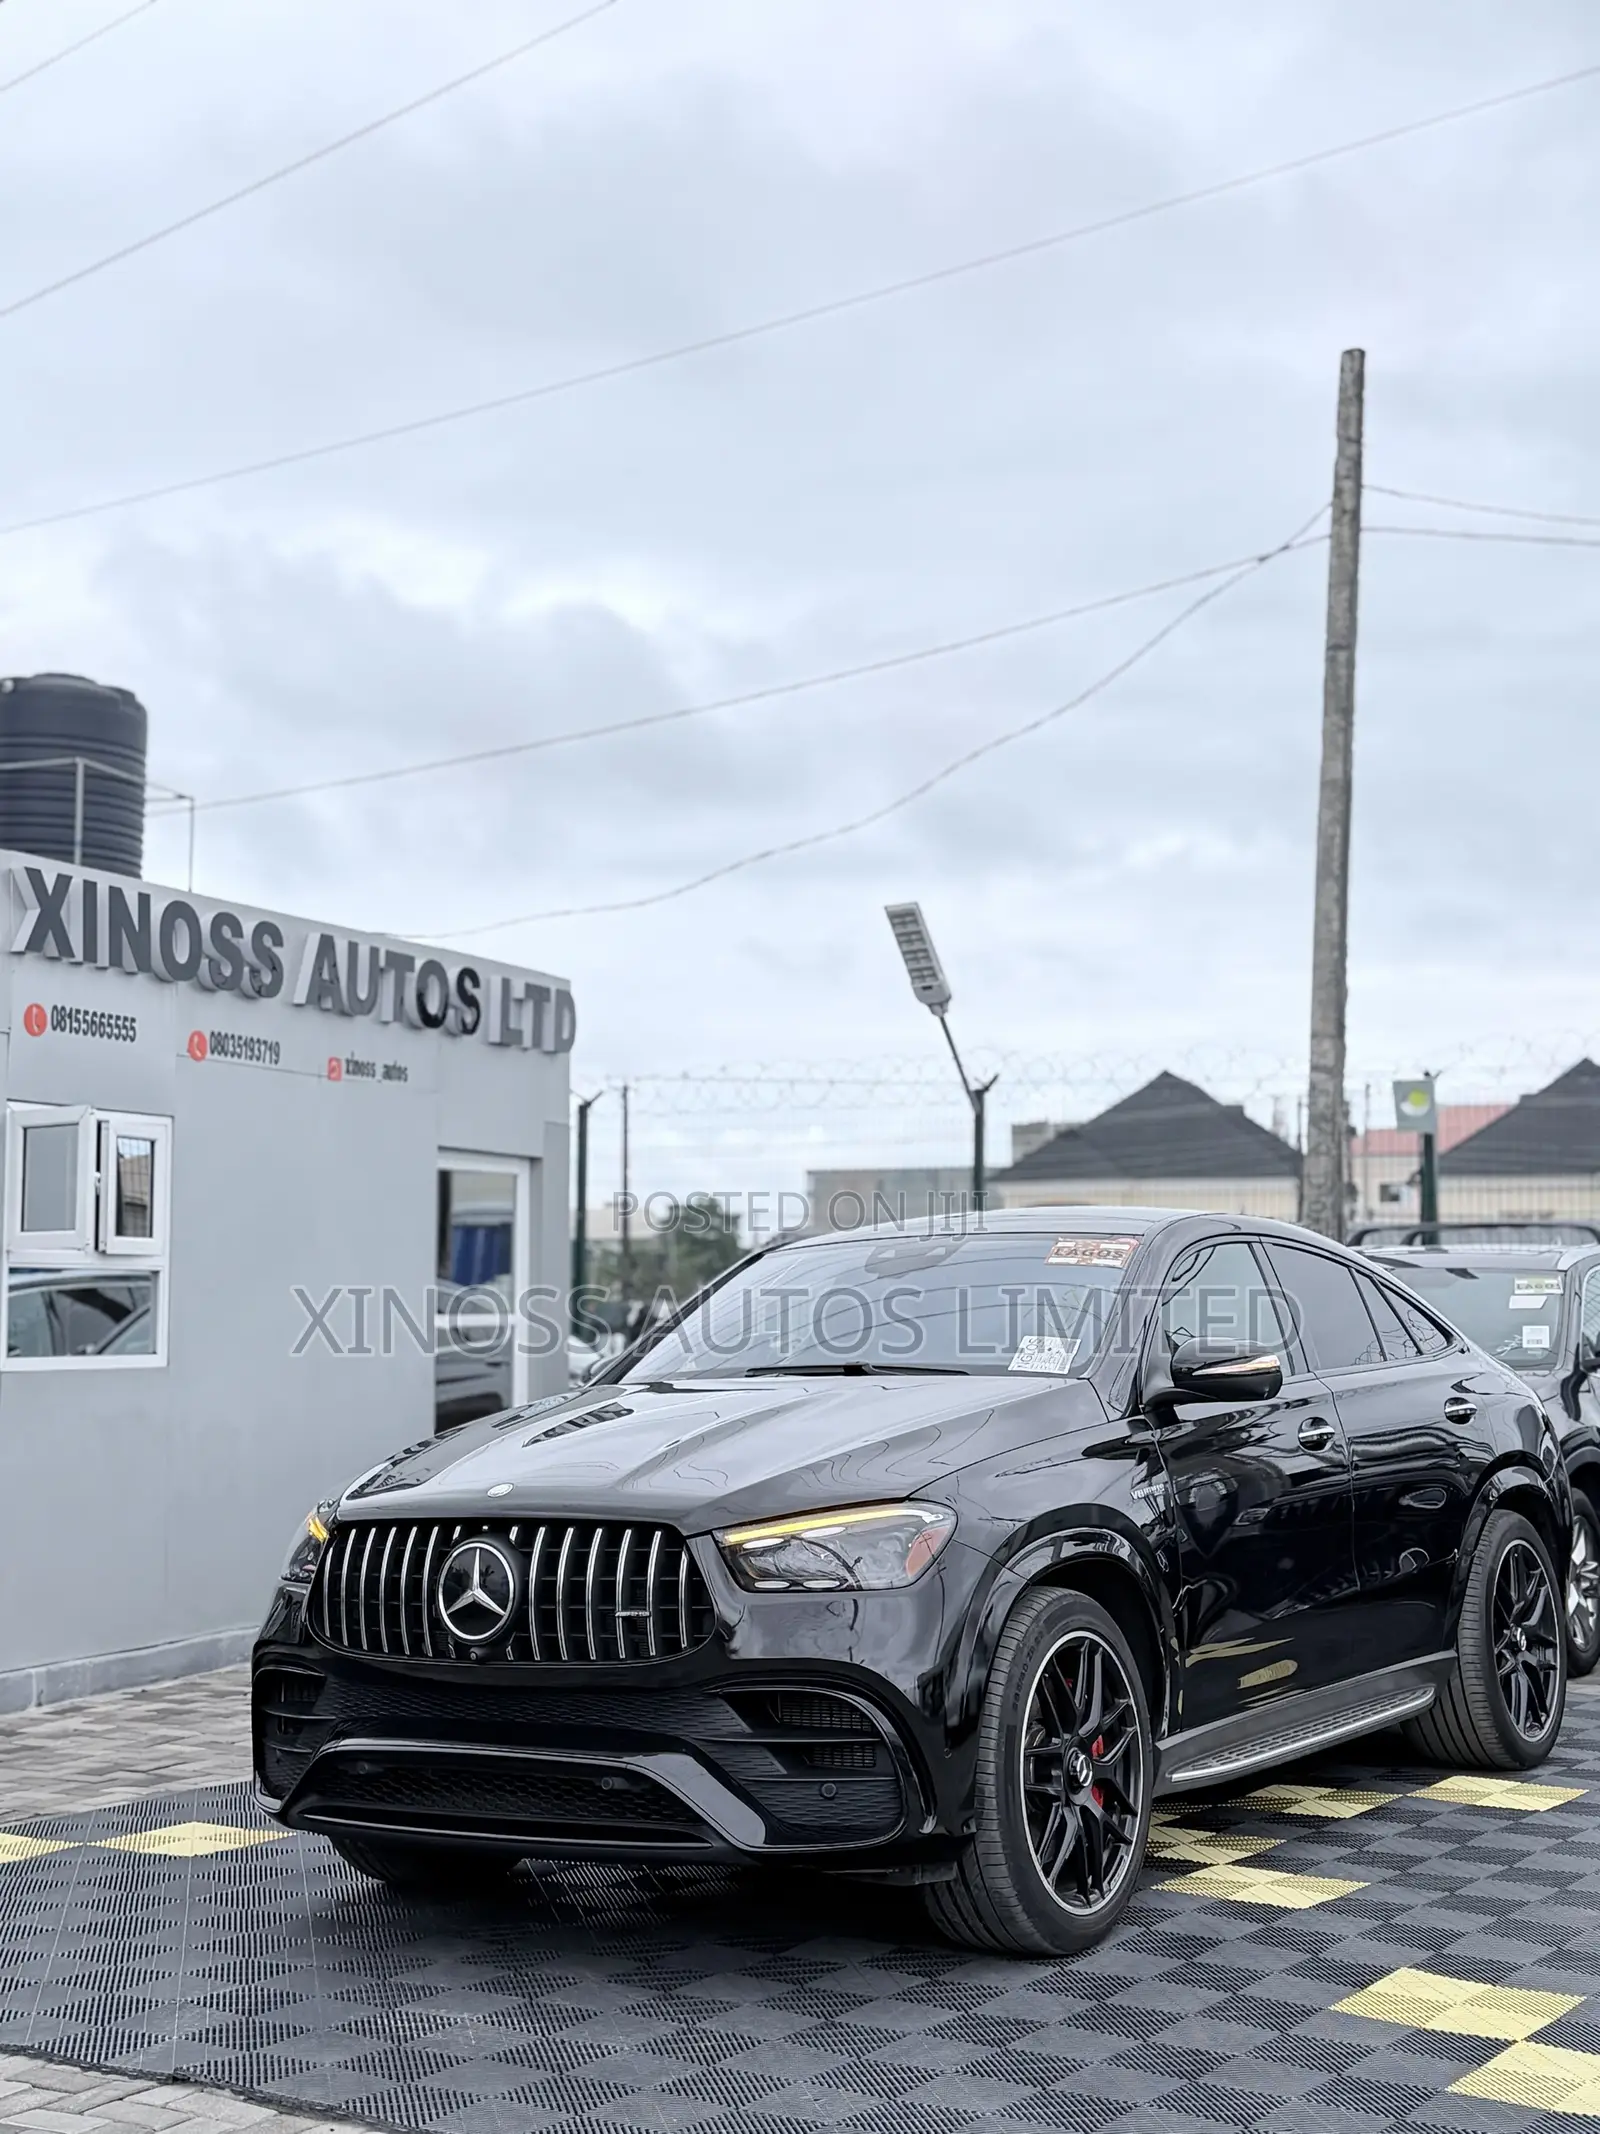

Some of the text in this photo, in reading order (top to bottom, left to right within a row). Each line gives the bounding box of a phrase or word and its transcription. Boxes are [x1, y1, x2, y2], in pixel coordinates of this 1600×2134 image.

[18, 866, 577, 1053] XINOSS AUTOS LTD
[51, 1004, 137, 1042] 08155665555
[209, 1031, 281, 1065] 08035193719
[1054, 1248, 1124, 1258] LAGOS
